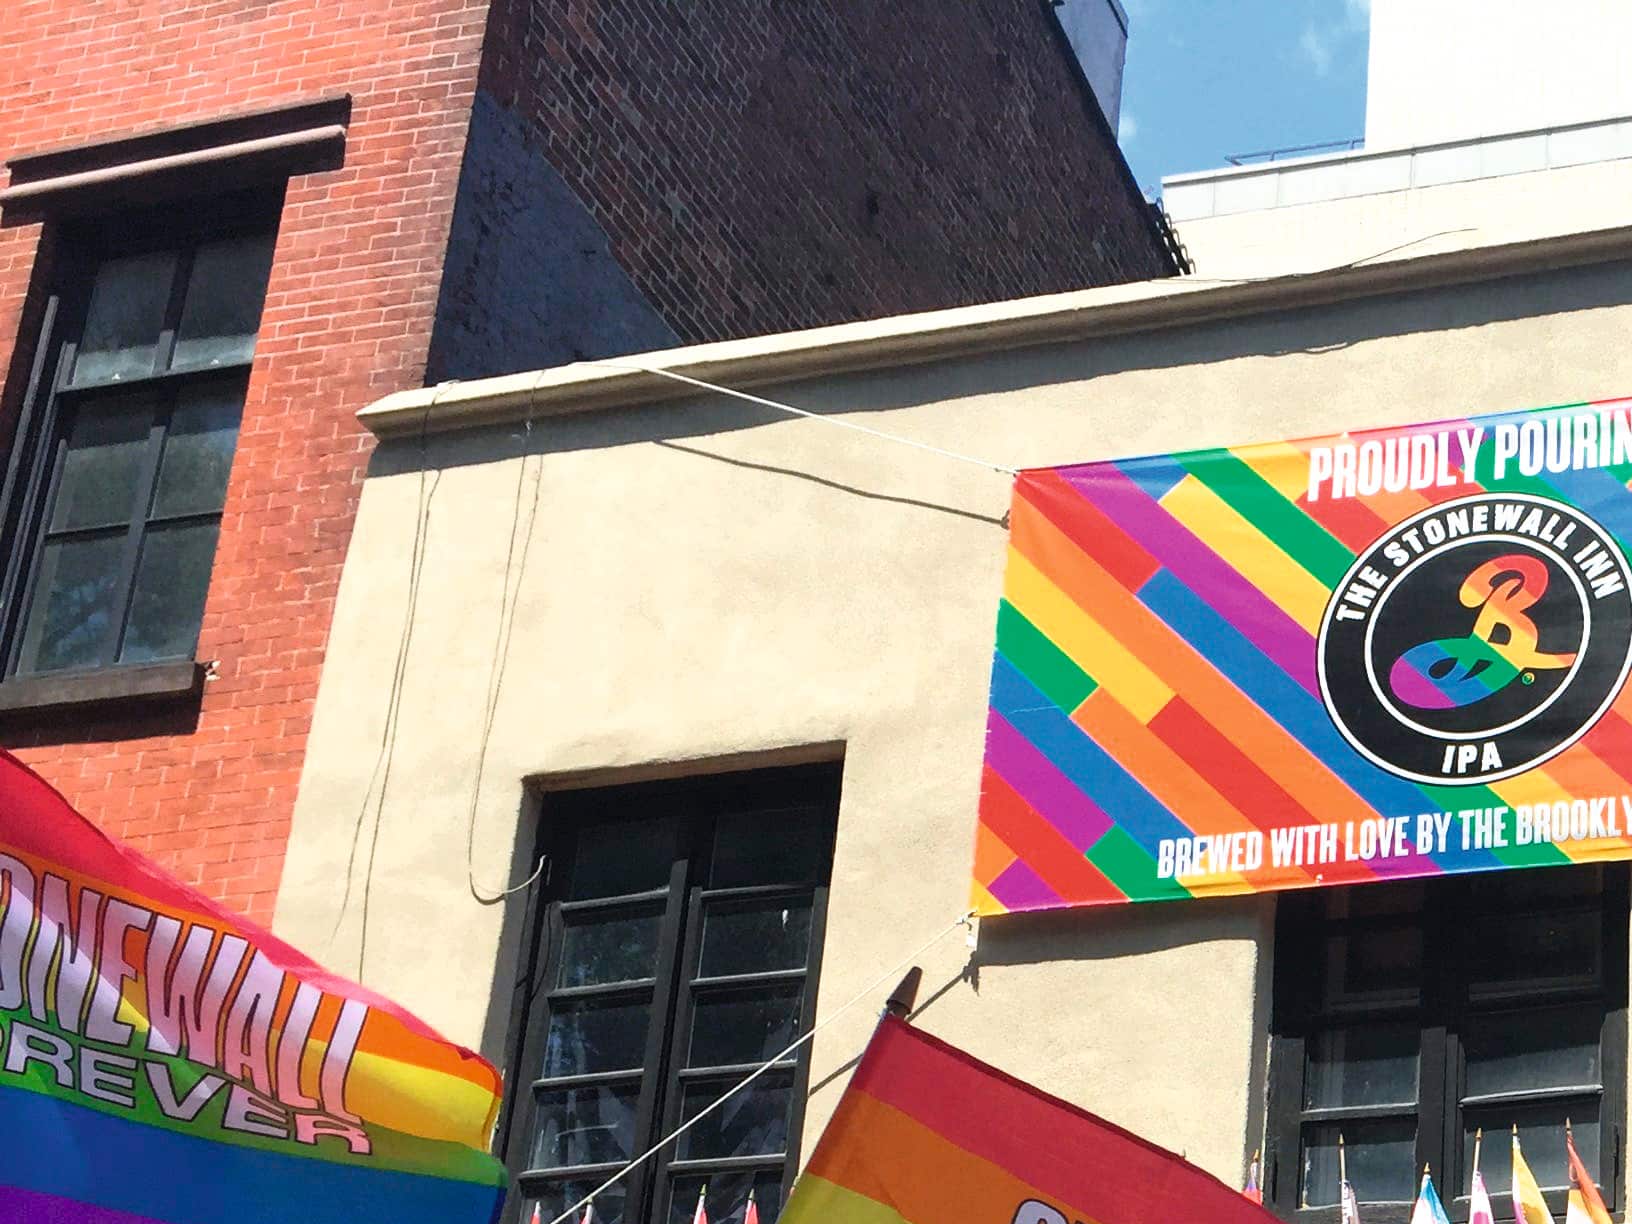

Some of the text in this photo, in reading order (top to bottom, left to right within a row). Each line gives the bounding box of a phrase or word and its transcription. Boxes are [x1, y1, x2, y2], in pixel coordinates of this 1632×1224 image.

[1308, 425, 1488, 502] PROUDLY
[1336, 504, 1625, 623] THE STONEWALL INN
[1441, 741, 1503, 774] IPA
[1157, 830, 1263, 879] BREWED
[1270, 823, 1338, 868] WITH
[1345, 815, 1410, 862] LOVE
[1417, 810, 1452, 855] BY
[1458, 806, 1509, 850] THE
[0, 1019, 372, 1155] REVER
